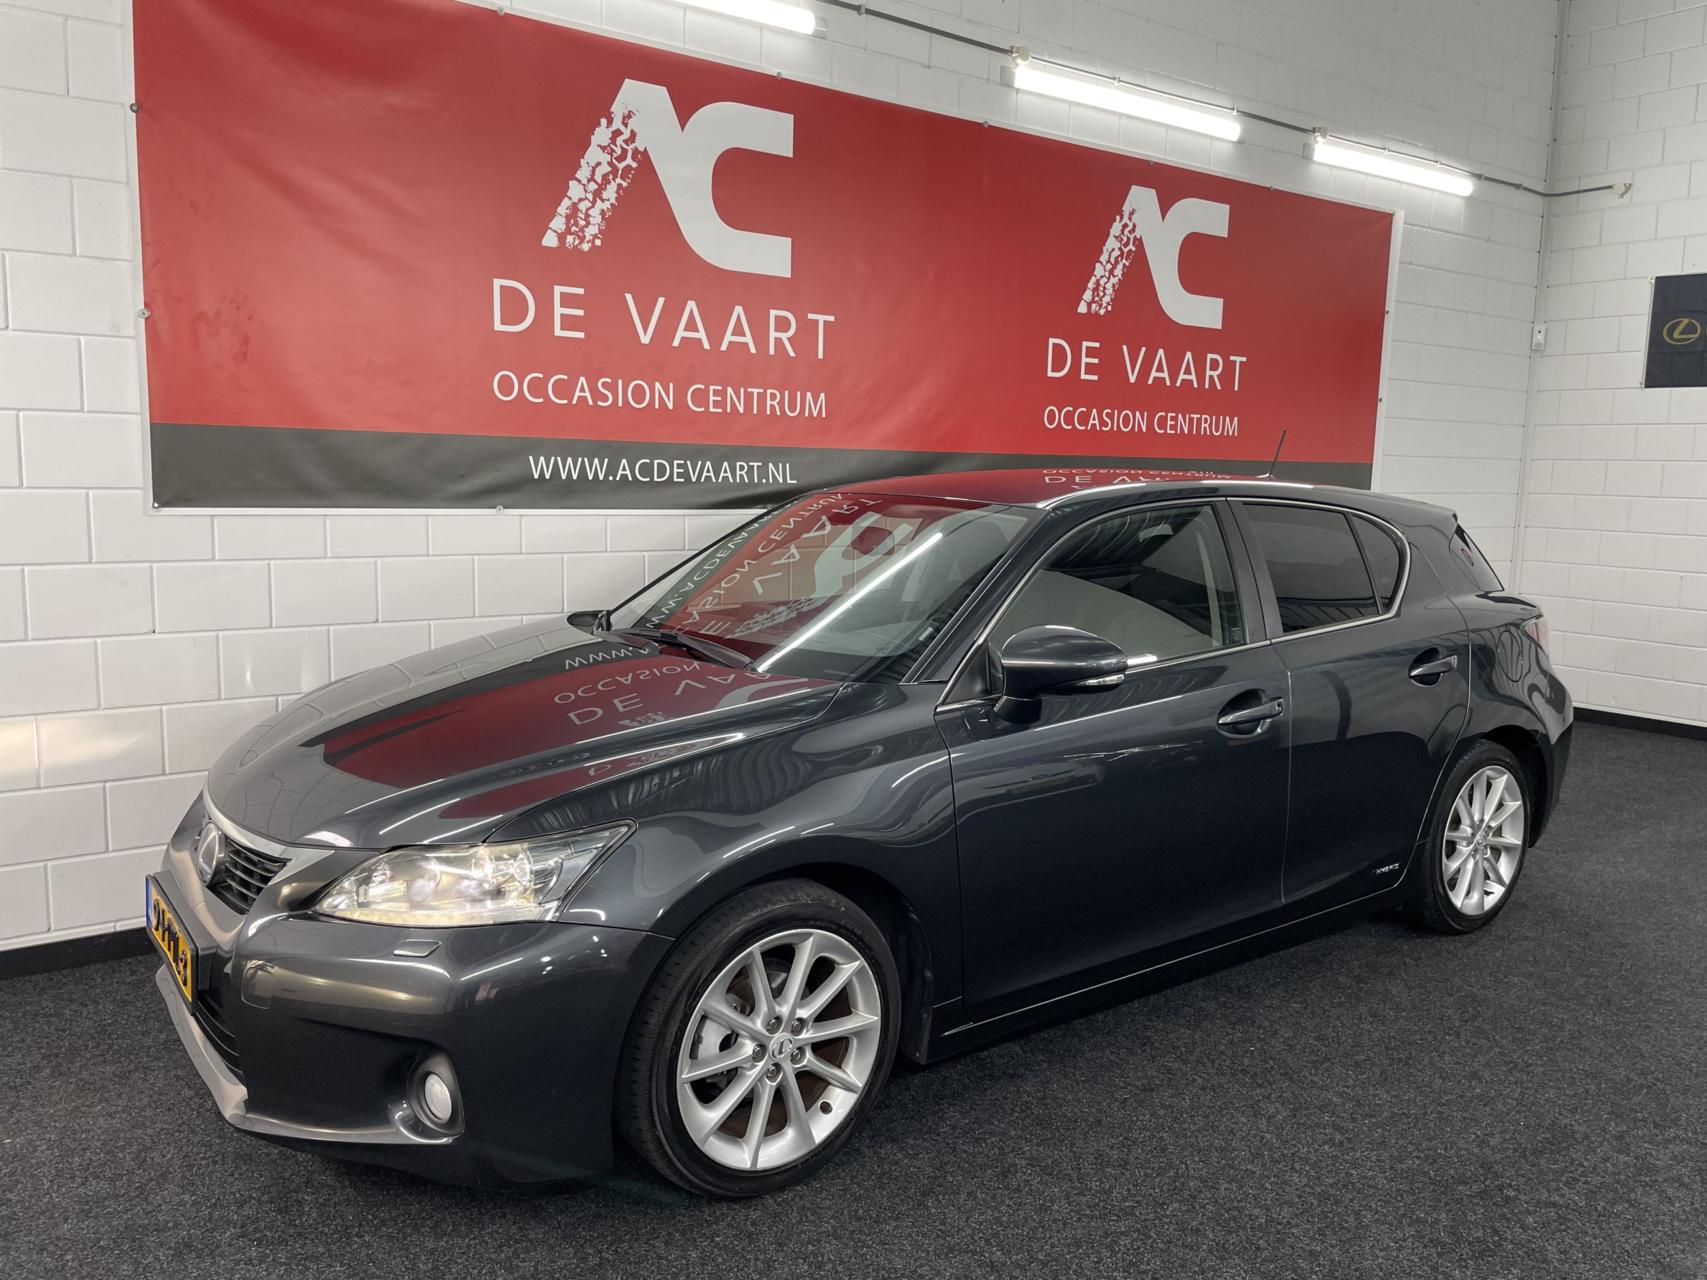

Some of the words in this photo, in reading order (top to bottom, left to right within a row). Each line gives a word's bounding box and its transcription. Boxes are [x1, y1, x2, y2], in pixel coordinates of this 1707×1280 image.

[492, 277, 586, 339] DE
[624, 292, 836, 360] VAART
[1046, 337, 1101, 381] DE
[1121, 344, 1248, 391] VAART
[492, 370, 675, 410] OCCASION
[686, 383, 827, 418] CENTRUM
[1043, 405, 1148, 433] OCCASION
[1153, 411, 1238, 437] CENTRUM
[528, 455, 798, 484] WWW.ACDEVAART.NL
